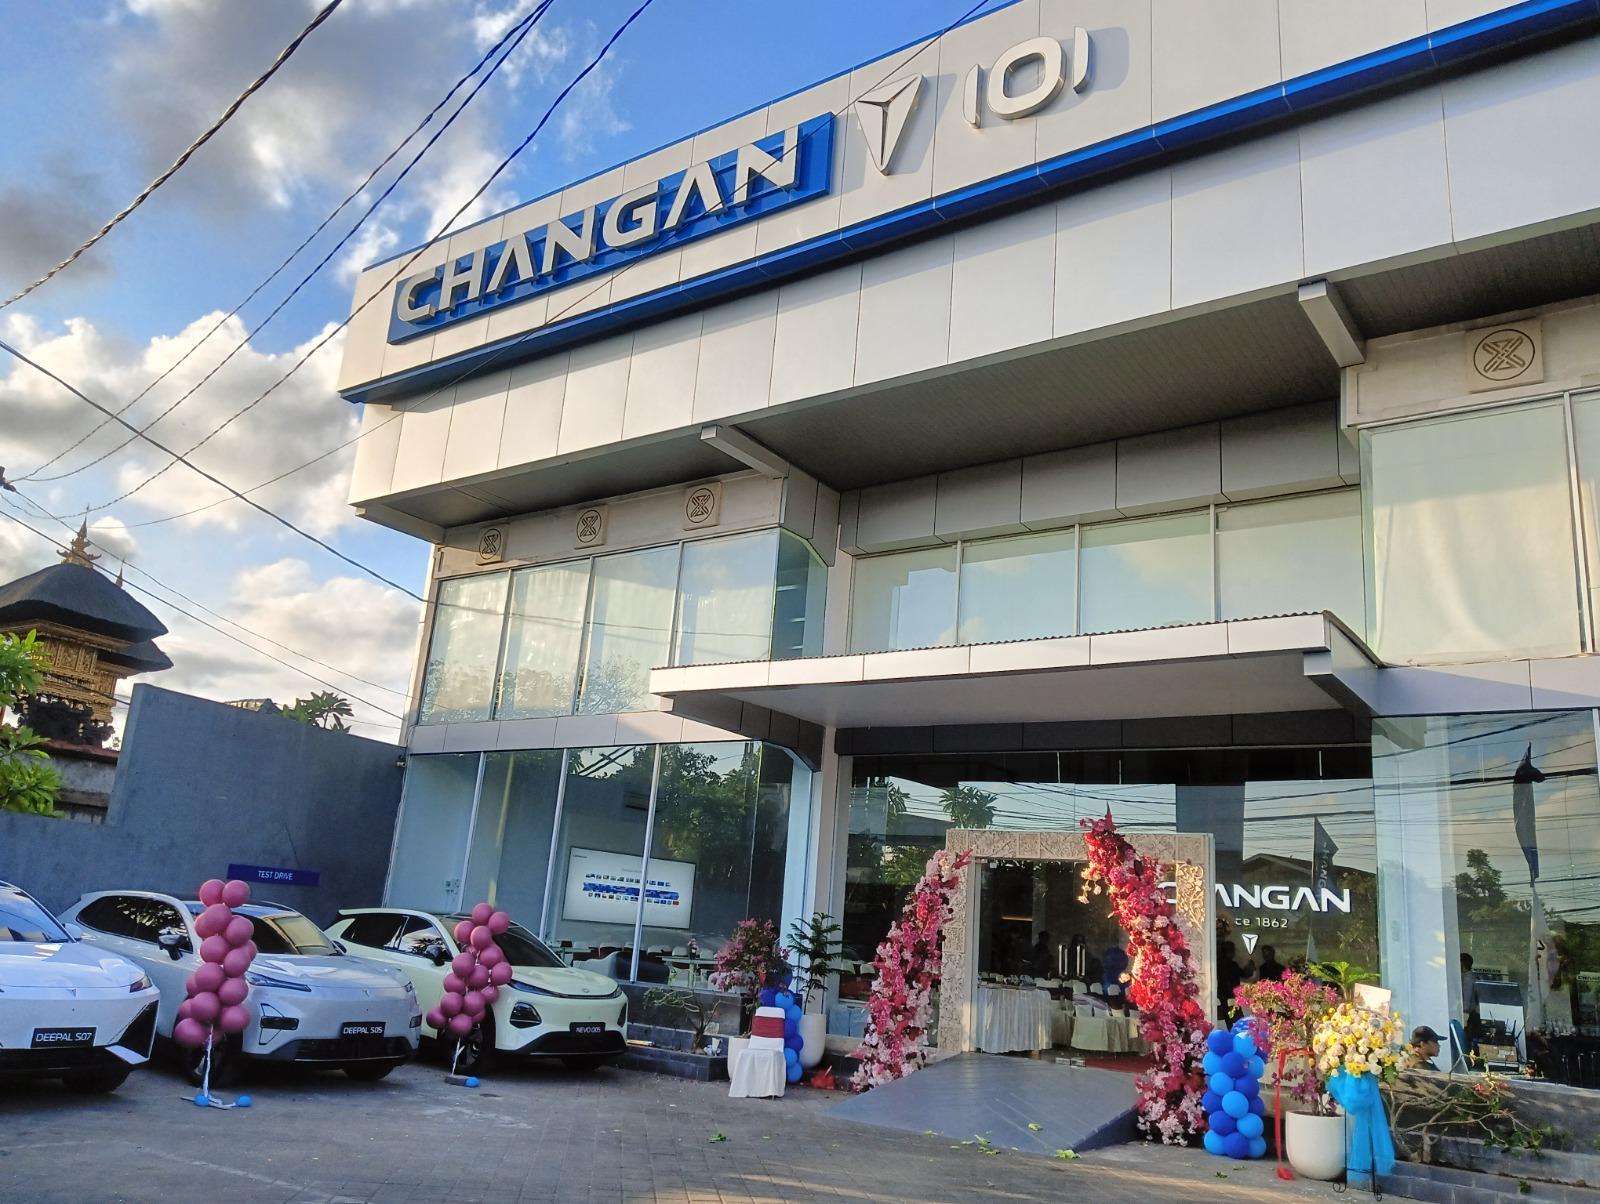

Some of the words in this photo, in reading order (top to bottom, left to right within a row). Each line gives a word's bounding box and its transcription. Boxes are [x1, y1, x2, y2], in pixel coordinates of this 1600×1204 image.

[397, 124, 801, 324] CHANGAN
[258, 870, 273, 879] TEST
[274, 871, 294, 880] DRIVE
[1255, 917, 1288, 929] 1862
[343, 1026, 369, 1034] DEEPAL
[370, 1026, 383, 1034] S05
[35, 1033, 73, 1042] DEEPAL
[75, 1032, 92, 1041] S07
